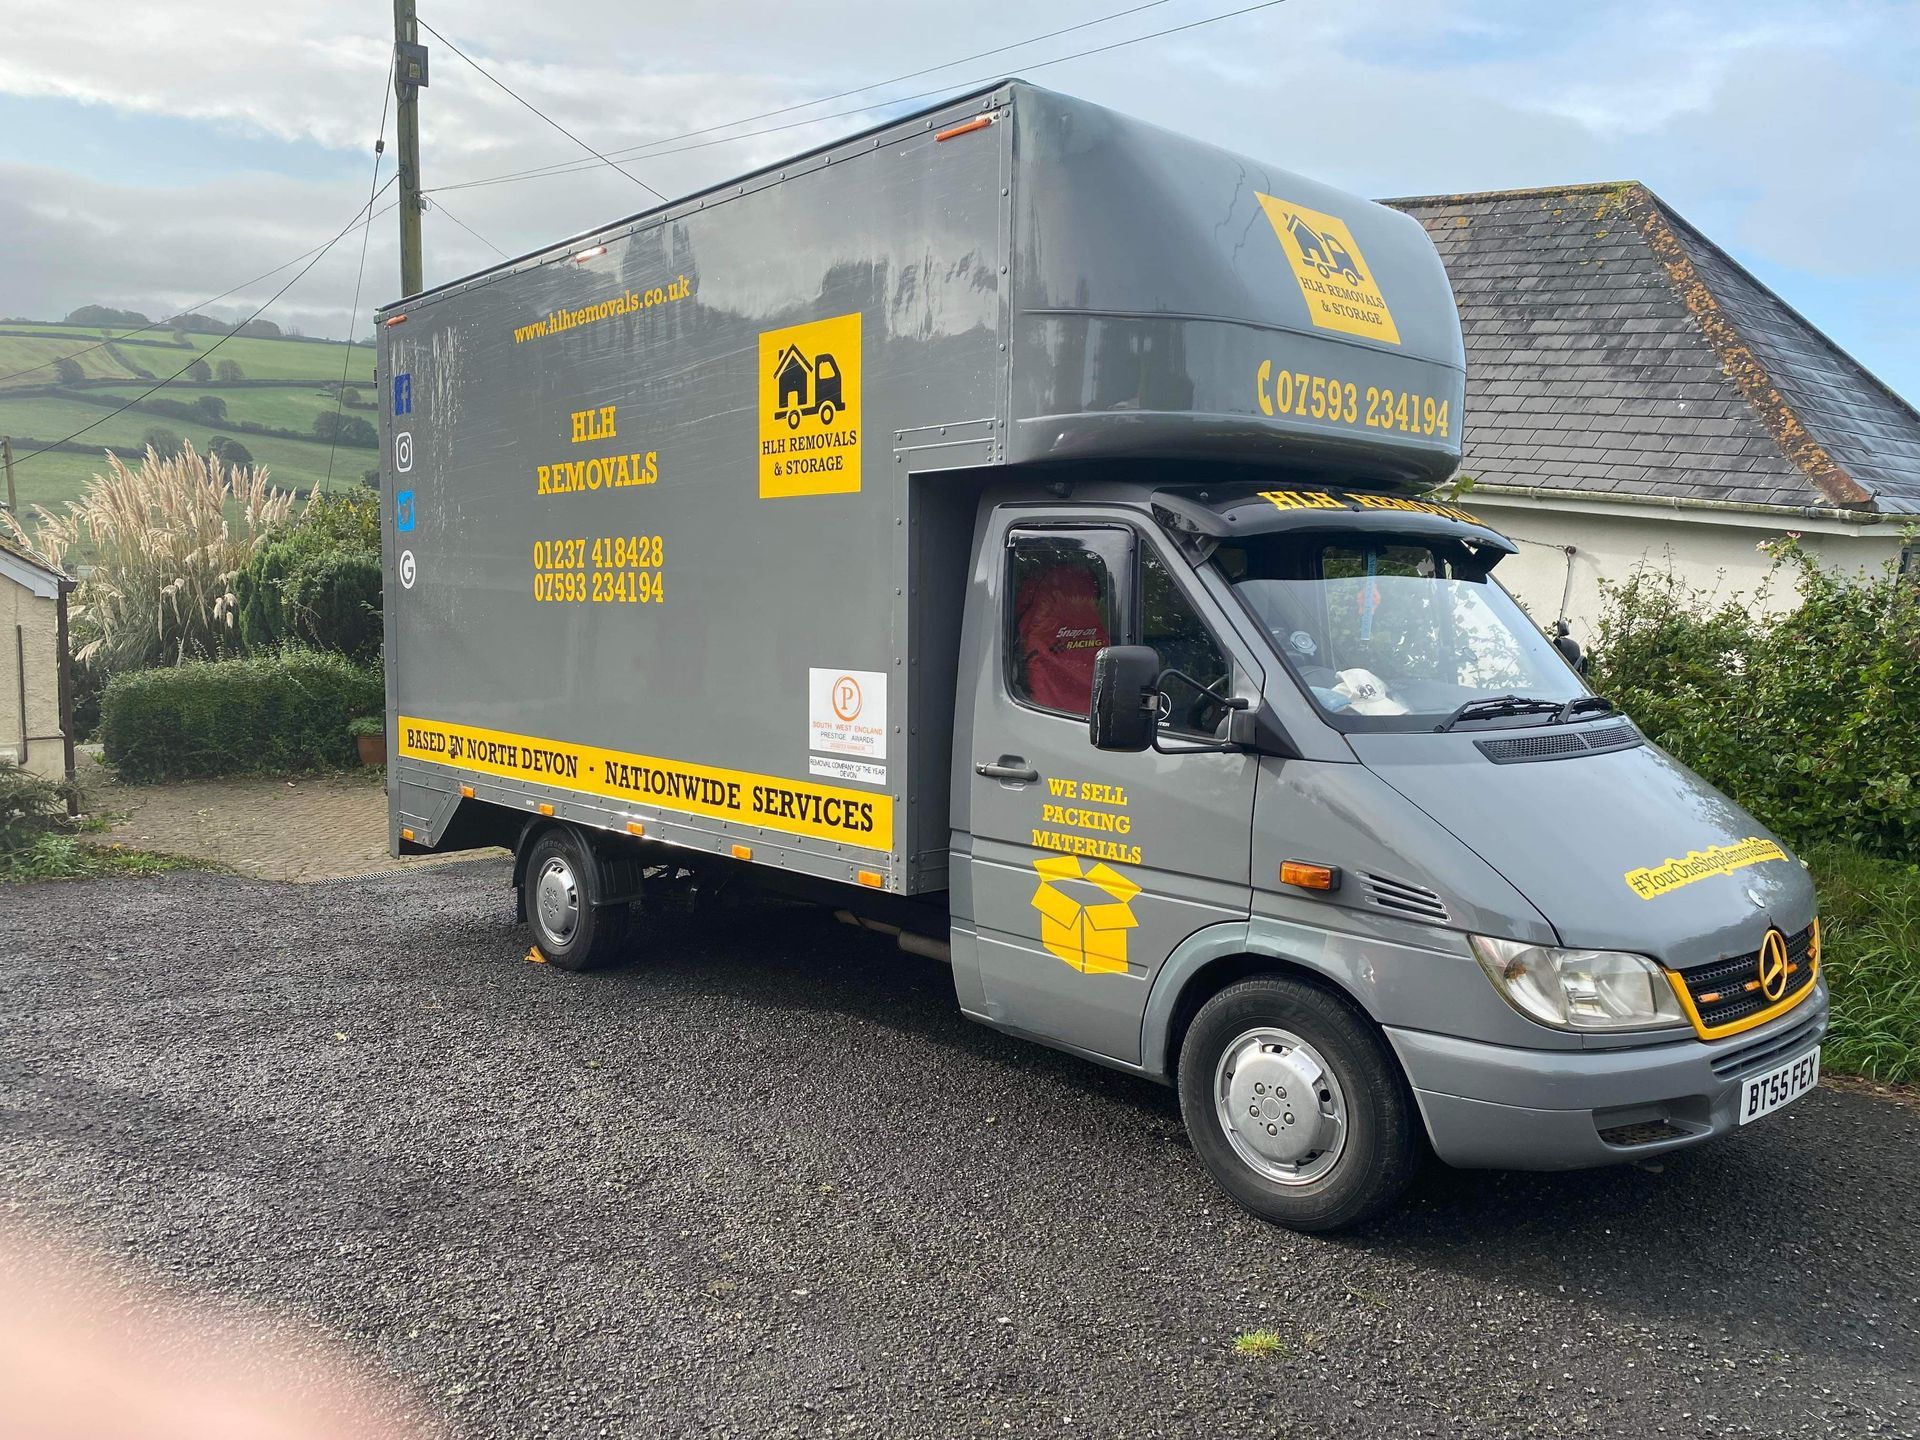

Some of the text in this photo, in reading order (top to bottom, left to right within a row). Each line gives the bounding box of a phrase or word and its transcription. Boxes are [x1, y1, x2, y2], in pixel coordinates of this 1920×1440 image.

[1300, 276, 1385, 309] HLH REMOVALS
[514, 275, 691, 344] www.hlhremovals.co.uk
[1321, 299, 1383, 325] & STORAGE
[1276, 369, 1449, 438] 07593 234194
[571, 406, 616, 443] HLH
[762, 430, 857, 456] HLH REMOVALS
[537, 451, 658, 495] REMOVALS
[774, 455, 843, 477] & STORAGE
[1257, 491, 1348, 511] HLH
[533, 535, 664, 570] 01237 418428
[533, 571, 664, 603] 07593 234194
[1056, 626, 1097, 639] Snap-on
[1066, 639, 1103, 650] RACING
[841, 686, 854, 710] P
[813, 721, 883, 736] SOUTH WEST ENGLAND
[820, 731, 874, 744] PRESTIGE AWARDS
[407, 729, 446, 752] BASED
[467, 738, 517, 768] NORTH
[521, 747, 578, 778] DEVON
[604, 760, 741, 810] NATIONWIDE
[752, 785, 873, 833] SERVICES
[810, 758, 831, 768] REMOVAL
[832, 762, 854, 771] COMPANY
[856, 765, 862, 773] OF
[872, 768, 885, 776] YEAR
[840, 770, 857, 779] DEVON
[1048, 778, 1128, 806] WE SELL
[1042, 804, 1131, 834] PACKING
[1031, 829, 1142, 865] MATERIALS
[1748, 1053, 1816, 1116] BT55 FEX
